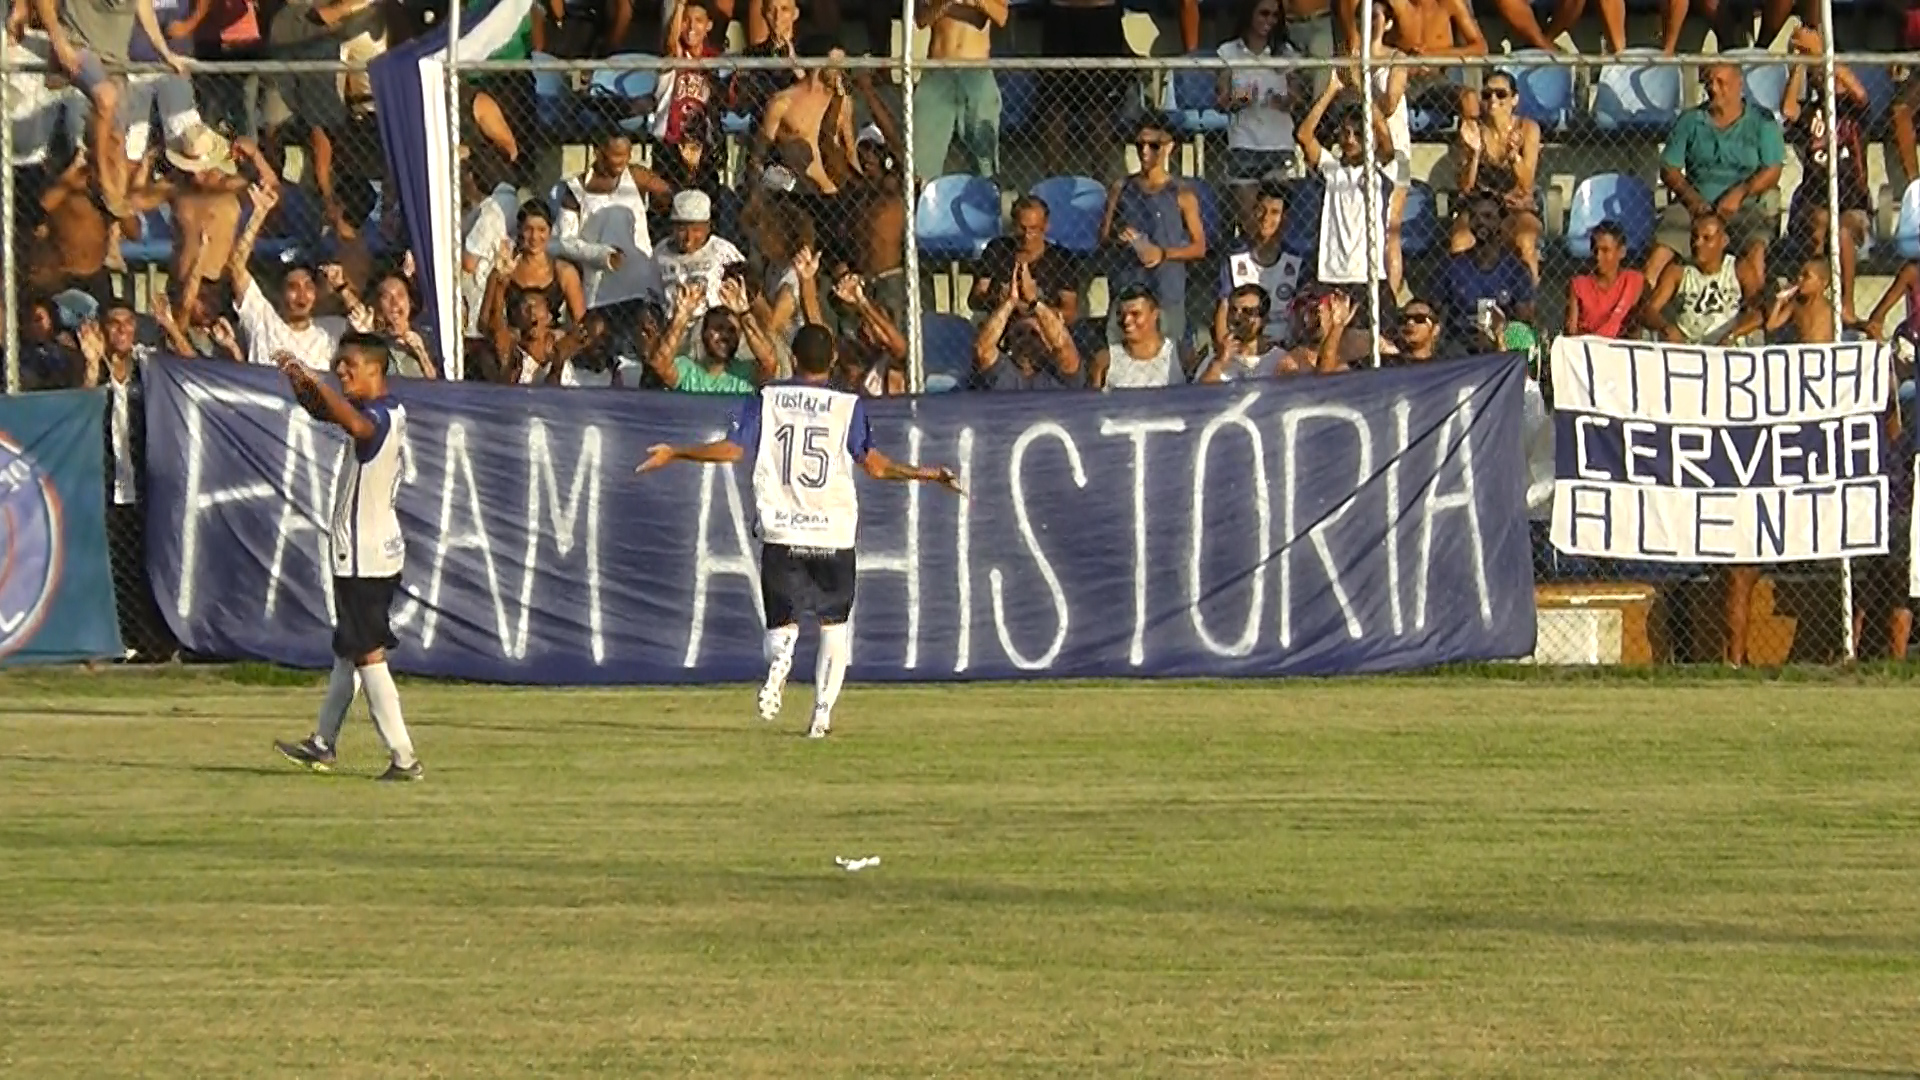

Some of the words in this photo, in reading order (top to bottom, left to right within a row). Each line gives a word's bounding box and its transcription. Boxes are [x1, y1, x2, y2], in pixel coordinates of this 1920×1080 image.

[775, 424, 829, 488] 15
[1575, 413, 1880, 487] CERVEJA
[846, 386, 1494, 674] HISTÓRIA
[1571, 480, 1882, 557] ALENTO
